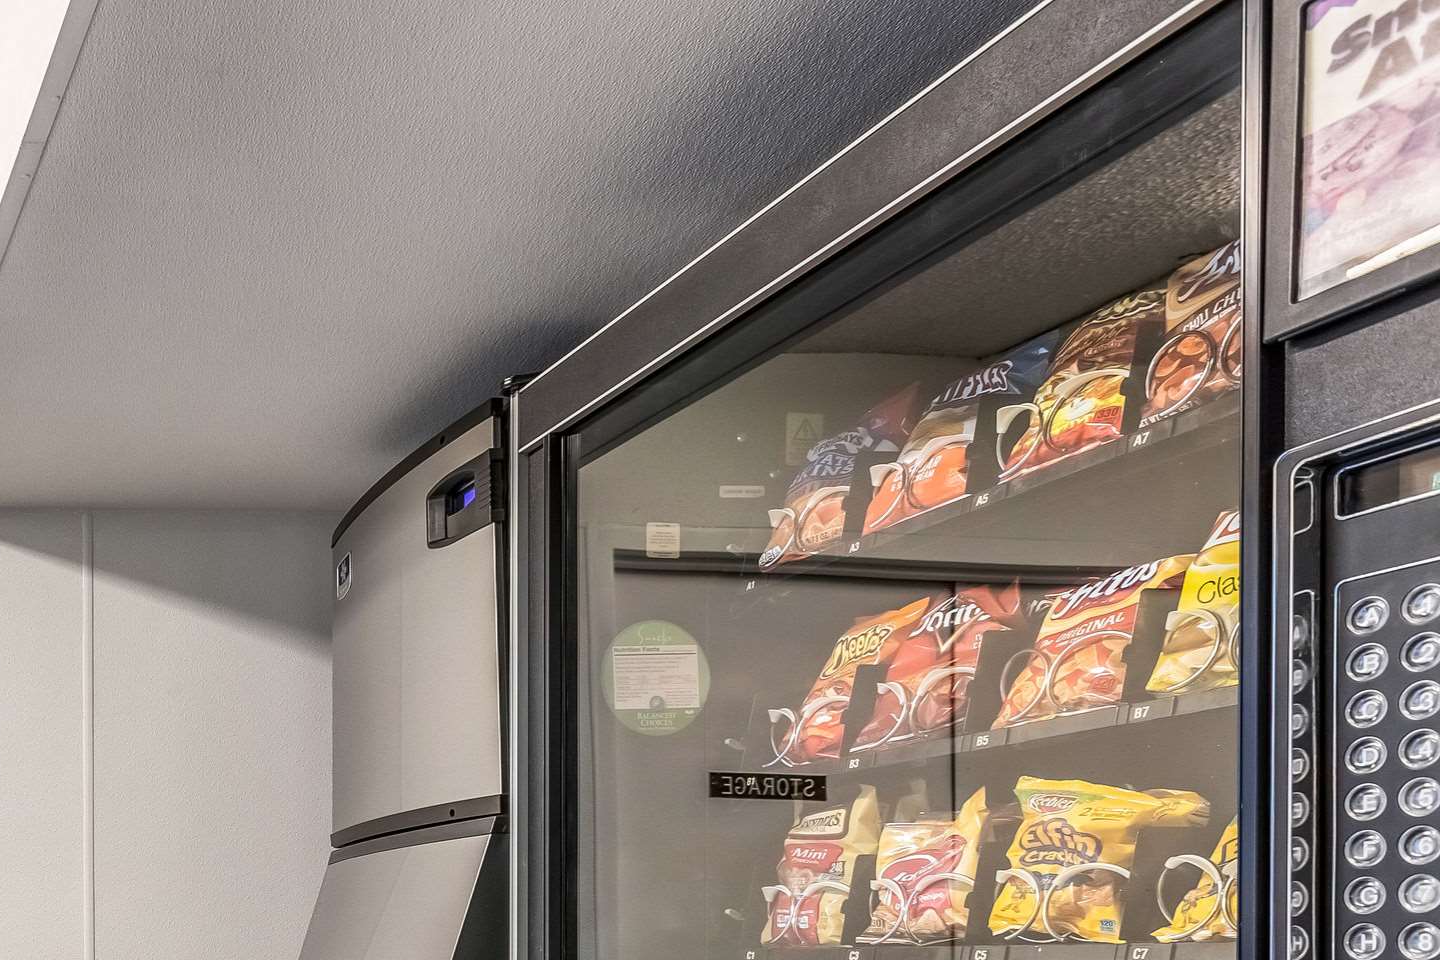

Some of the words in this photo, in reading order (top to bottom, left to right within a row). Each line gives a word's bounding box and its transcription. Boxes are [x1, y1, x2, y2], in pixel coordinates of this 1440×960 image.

[1133, 432, 1150, 447] A7
[976, 494, 989, 506] A5
[849, 542, 860, 553] A3
[746, 580, 755, 591] A1
[1056, 612, 1126, 644] ORIGINAL
[1134, 706, 1150, 719] B7
[976, 735, 989, 747] B5
[849, 758, 860, 769] B3
[1020, 818, 1102, 859] Elfin
[792, 847, 827, 859] Mini
[746, 951, 755, 960] C1
[849, 951, 860, 960] C3
[974, 950, 987, 960] C5
[1132, 948, 1149, 960] C7
